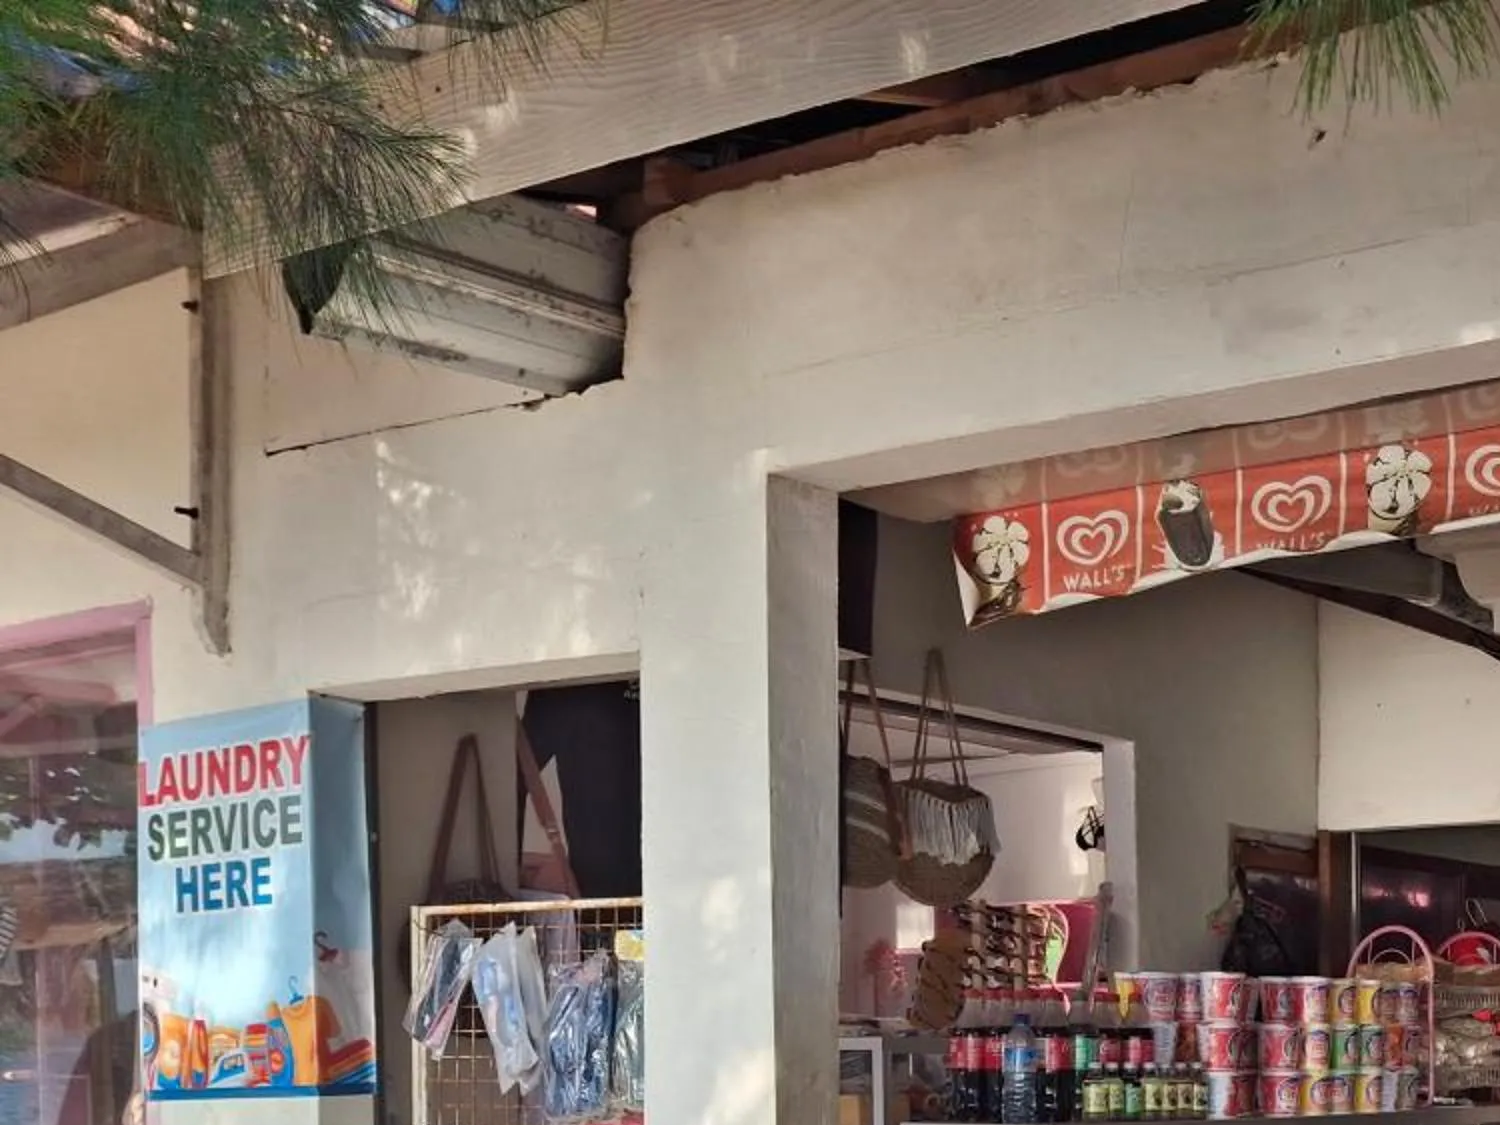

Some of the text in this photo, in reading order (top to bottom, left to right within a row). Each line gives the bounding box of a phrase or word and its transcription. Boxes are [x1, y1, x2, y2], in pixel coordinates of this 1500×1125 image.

[1062, 565, 1126, 593] WALL'S
[138, 734, 310, 807] LAUNDRY
[147, 796, 303, 861] SERVICE
[175, 856, 272, 913] HERE
